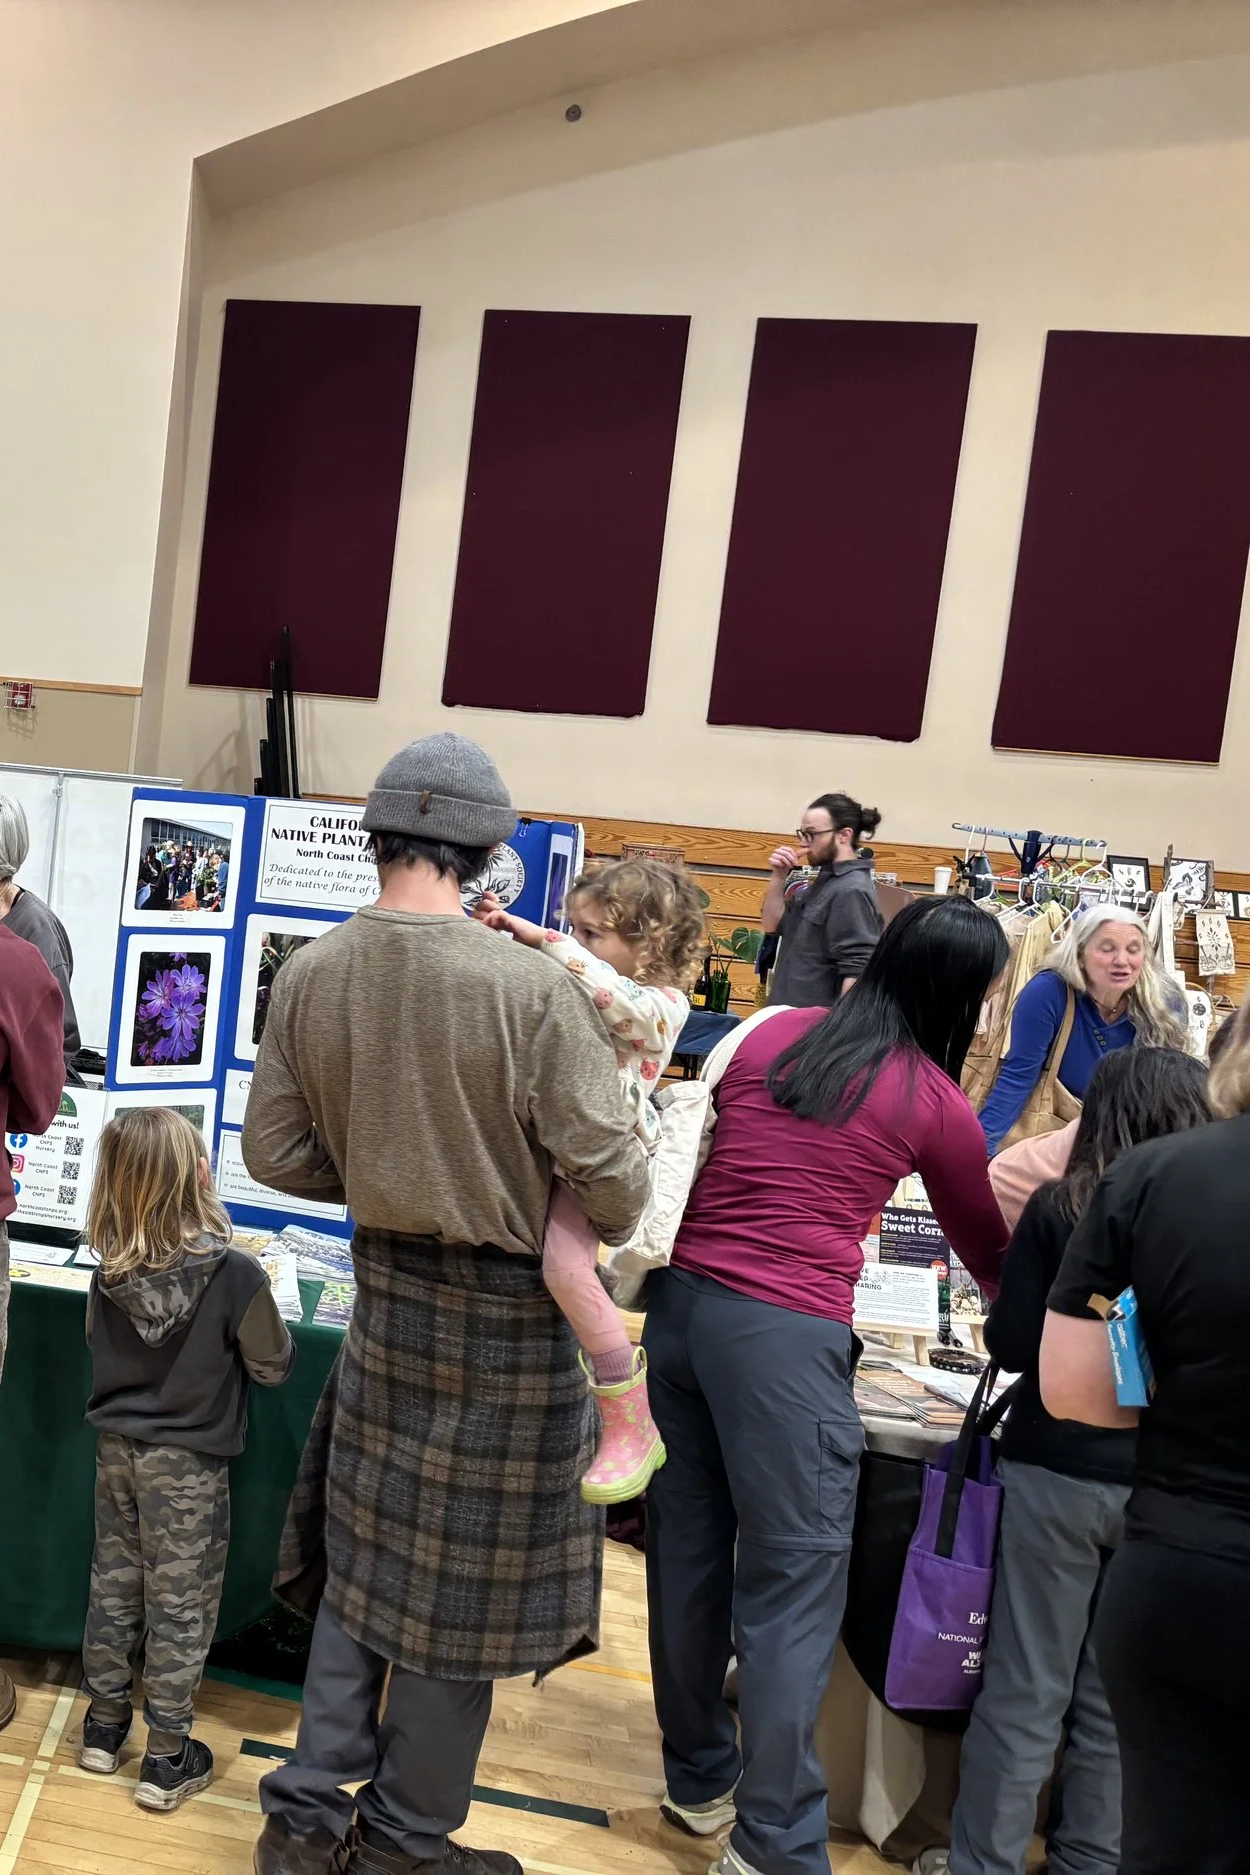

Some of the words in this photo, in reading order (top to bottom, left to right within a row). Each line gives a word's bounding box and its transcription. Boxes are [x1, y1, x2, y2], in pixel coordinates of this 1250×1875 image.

[271, 828, 317, 842] NATIVE
[322, 832, 366, 847] PLANT
[296, 848, 323, 859] North
[327, 851, 354, 862] Coast
[269, 864, 321, 876] Dedicated
[337, 870, 352, 880] the
[355, 874, 378, 882] pres
[514, 862, 523, 894] SOCIETY
[264, 876, 274, 887] of
[276, 876, 292, 886] the
[296, 880, 328, 890] native
[330, 882, 356, 893] flora
[359, 887, 371, 897] of
[881, 1212, 898, 1220] Who
[900, 1215, 916, 1223] Gets
[881, 1220, 916, 1233] Sweet
[854, 1282, 881, 1290] HARING
[938, 1632, 978, 1644] NATIONAL
